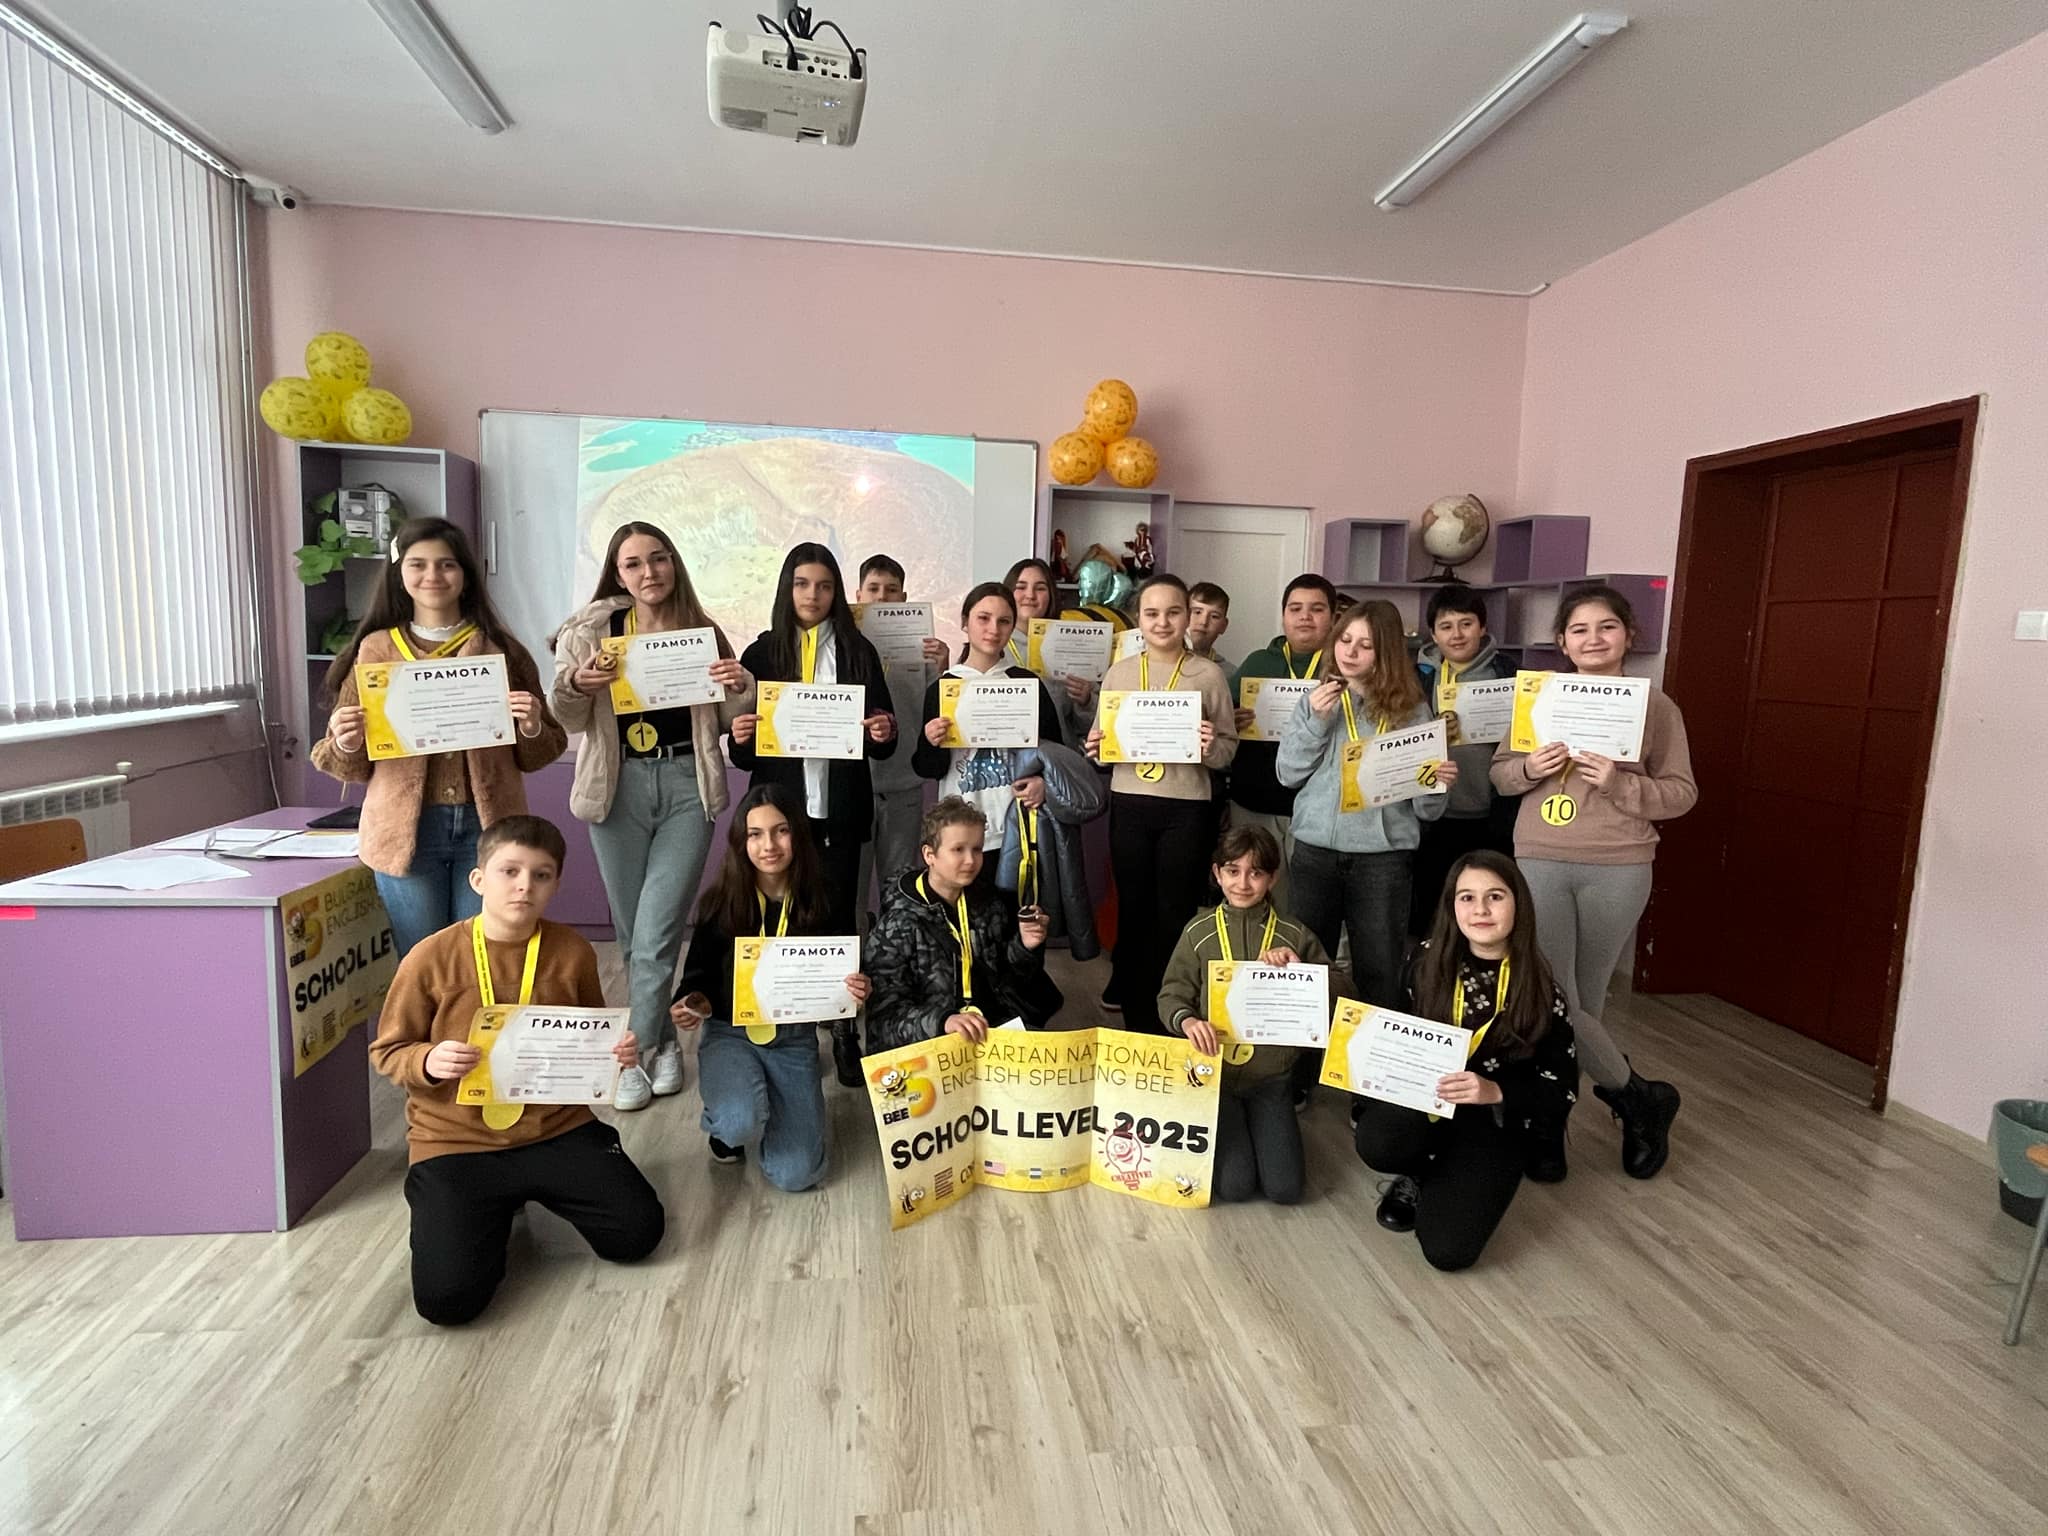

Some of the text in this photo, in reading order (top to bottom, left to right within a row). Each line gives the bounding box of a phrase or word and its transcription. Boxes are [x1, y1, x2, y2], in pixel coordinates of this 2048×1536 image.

[878, 609, 924, 618] ГРАМОТА
[1060, 627, 1104, 637] ГРАМОТА
[646, 638, 704, 650] ГРАМОТА
[414, 667, 490, 682] ГРАМОТА
[797, 692, 852, 702] ГРАМОТА
[976, 686, 1028, 695] ГРАМОТА
[1472, 685, 1515, 695] ГРАМОТ
[1562, 684, 1632, 698] ГРАМОТА
[1136, 699, 1190, 708] ГРАМОТА
[635, 725, 645, 747] 1
[1379, 731, 1435, 752] ГРАМОТА
[1142, 762, 1155, 780] 2
[1544, 798, 1575, 822] 10
[782, 947, 846, 957] ГРАМОТА
[295, 941, 367, 1013] SCHOOL
[1252, 971, 1314, 982] ГРАМОТА
[531, 1018, 611, 1030] ГРАМОТА
[1383, 1020, 1454, 1047] ГРАМОТА
[937, 1042, 1175, 1072] BULGARIAN NATIONAL
[942, 1064, 1174, 1095] ENGLISH SPELLING BEE
[883, 1107, 910, 1125] BEE
[890, 1105, 1209, 1170] SCHOOL LEVEL 2025
